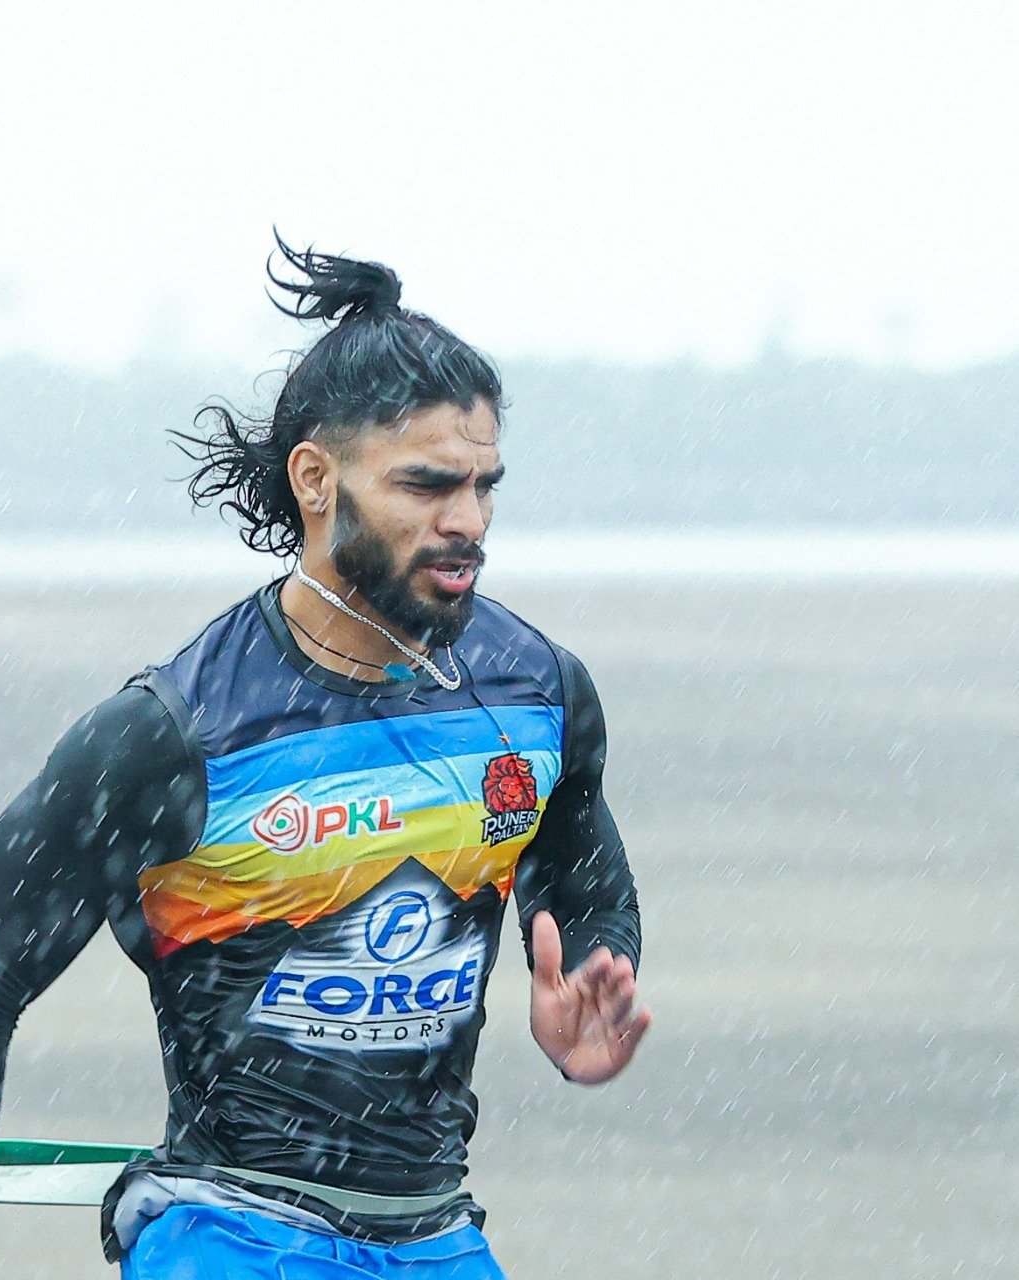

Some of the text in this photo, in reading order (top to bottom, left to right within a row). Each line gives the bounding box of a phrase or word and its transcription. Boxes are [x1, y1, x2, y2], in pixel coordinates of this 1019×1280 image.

[315, 799, 402, 844] PKL
[483, 810, 539, 841] PUNERI
[372, 903, 420, 949] F
[262, 959, 478, 1016] FORCE
[306, 1017, 445, 1042] MOTORS
